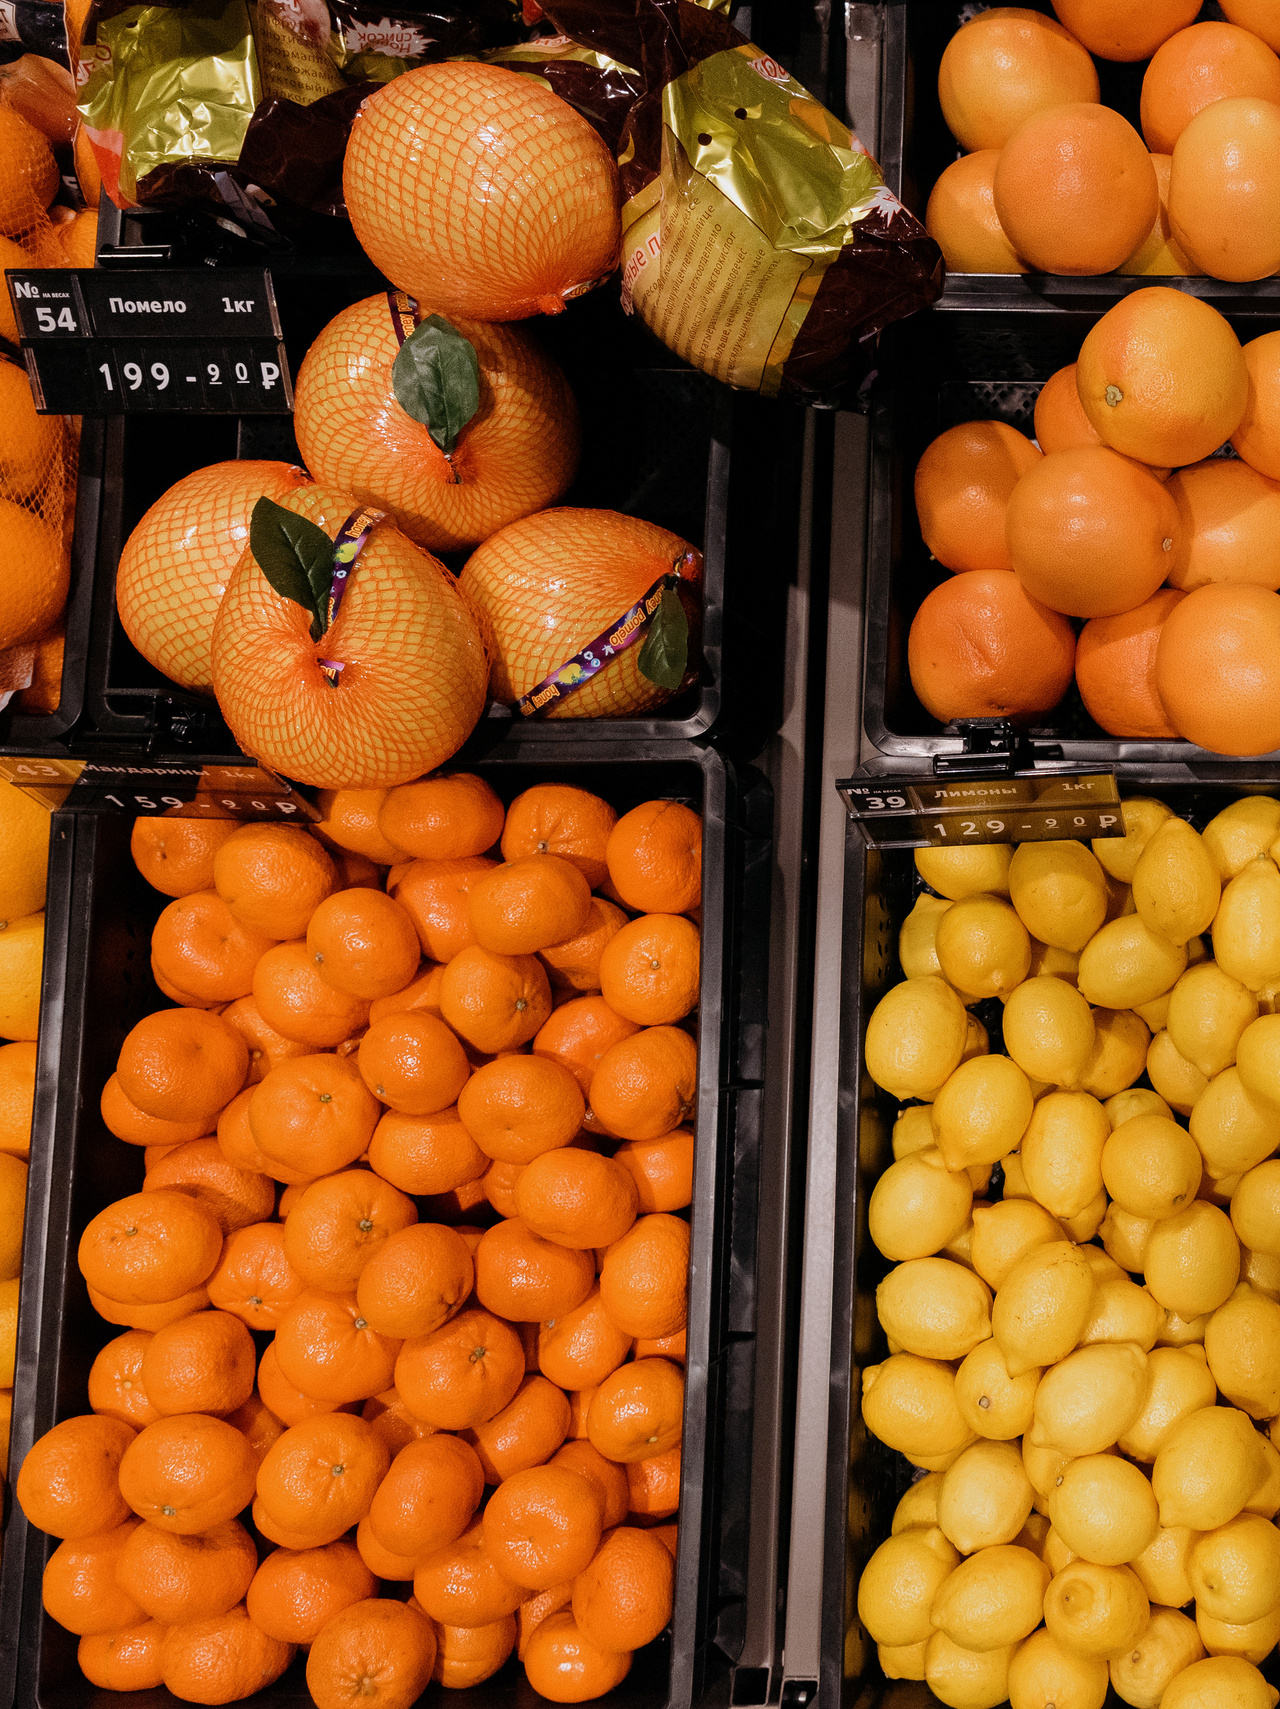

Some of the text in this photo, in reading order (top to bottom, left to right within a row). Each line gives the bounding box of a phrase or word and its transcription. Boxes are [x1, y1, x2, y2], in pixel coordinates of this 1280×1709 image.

[14, 282, 40, 298] №
[109, 298, 255, 313] Помело 1кг
[35, 307, 78, 332] 54
[345, 513, 373, 538] honey
[610, 608, 647, 646] pomelo
[532, 684, 560, 709] honey
[16, 764, 60, 776] 43
[78, 763, 211, 776] Мандарины
[935, 783, 1095, 798] Лимоны 1кг
[866, 796, 906, 810] 39
